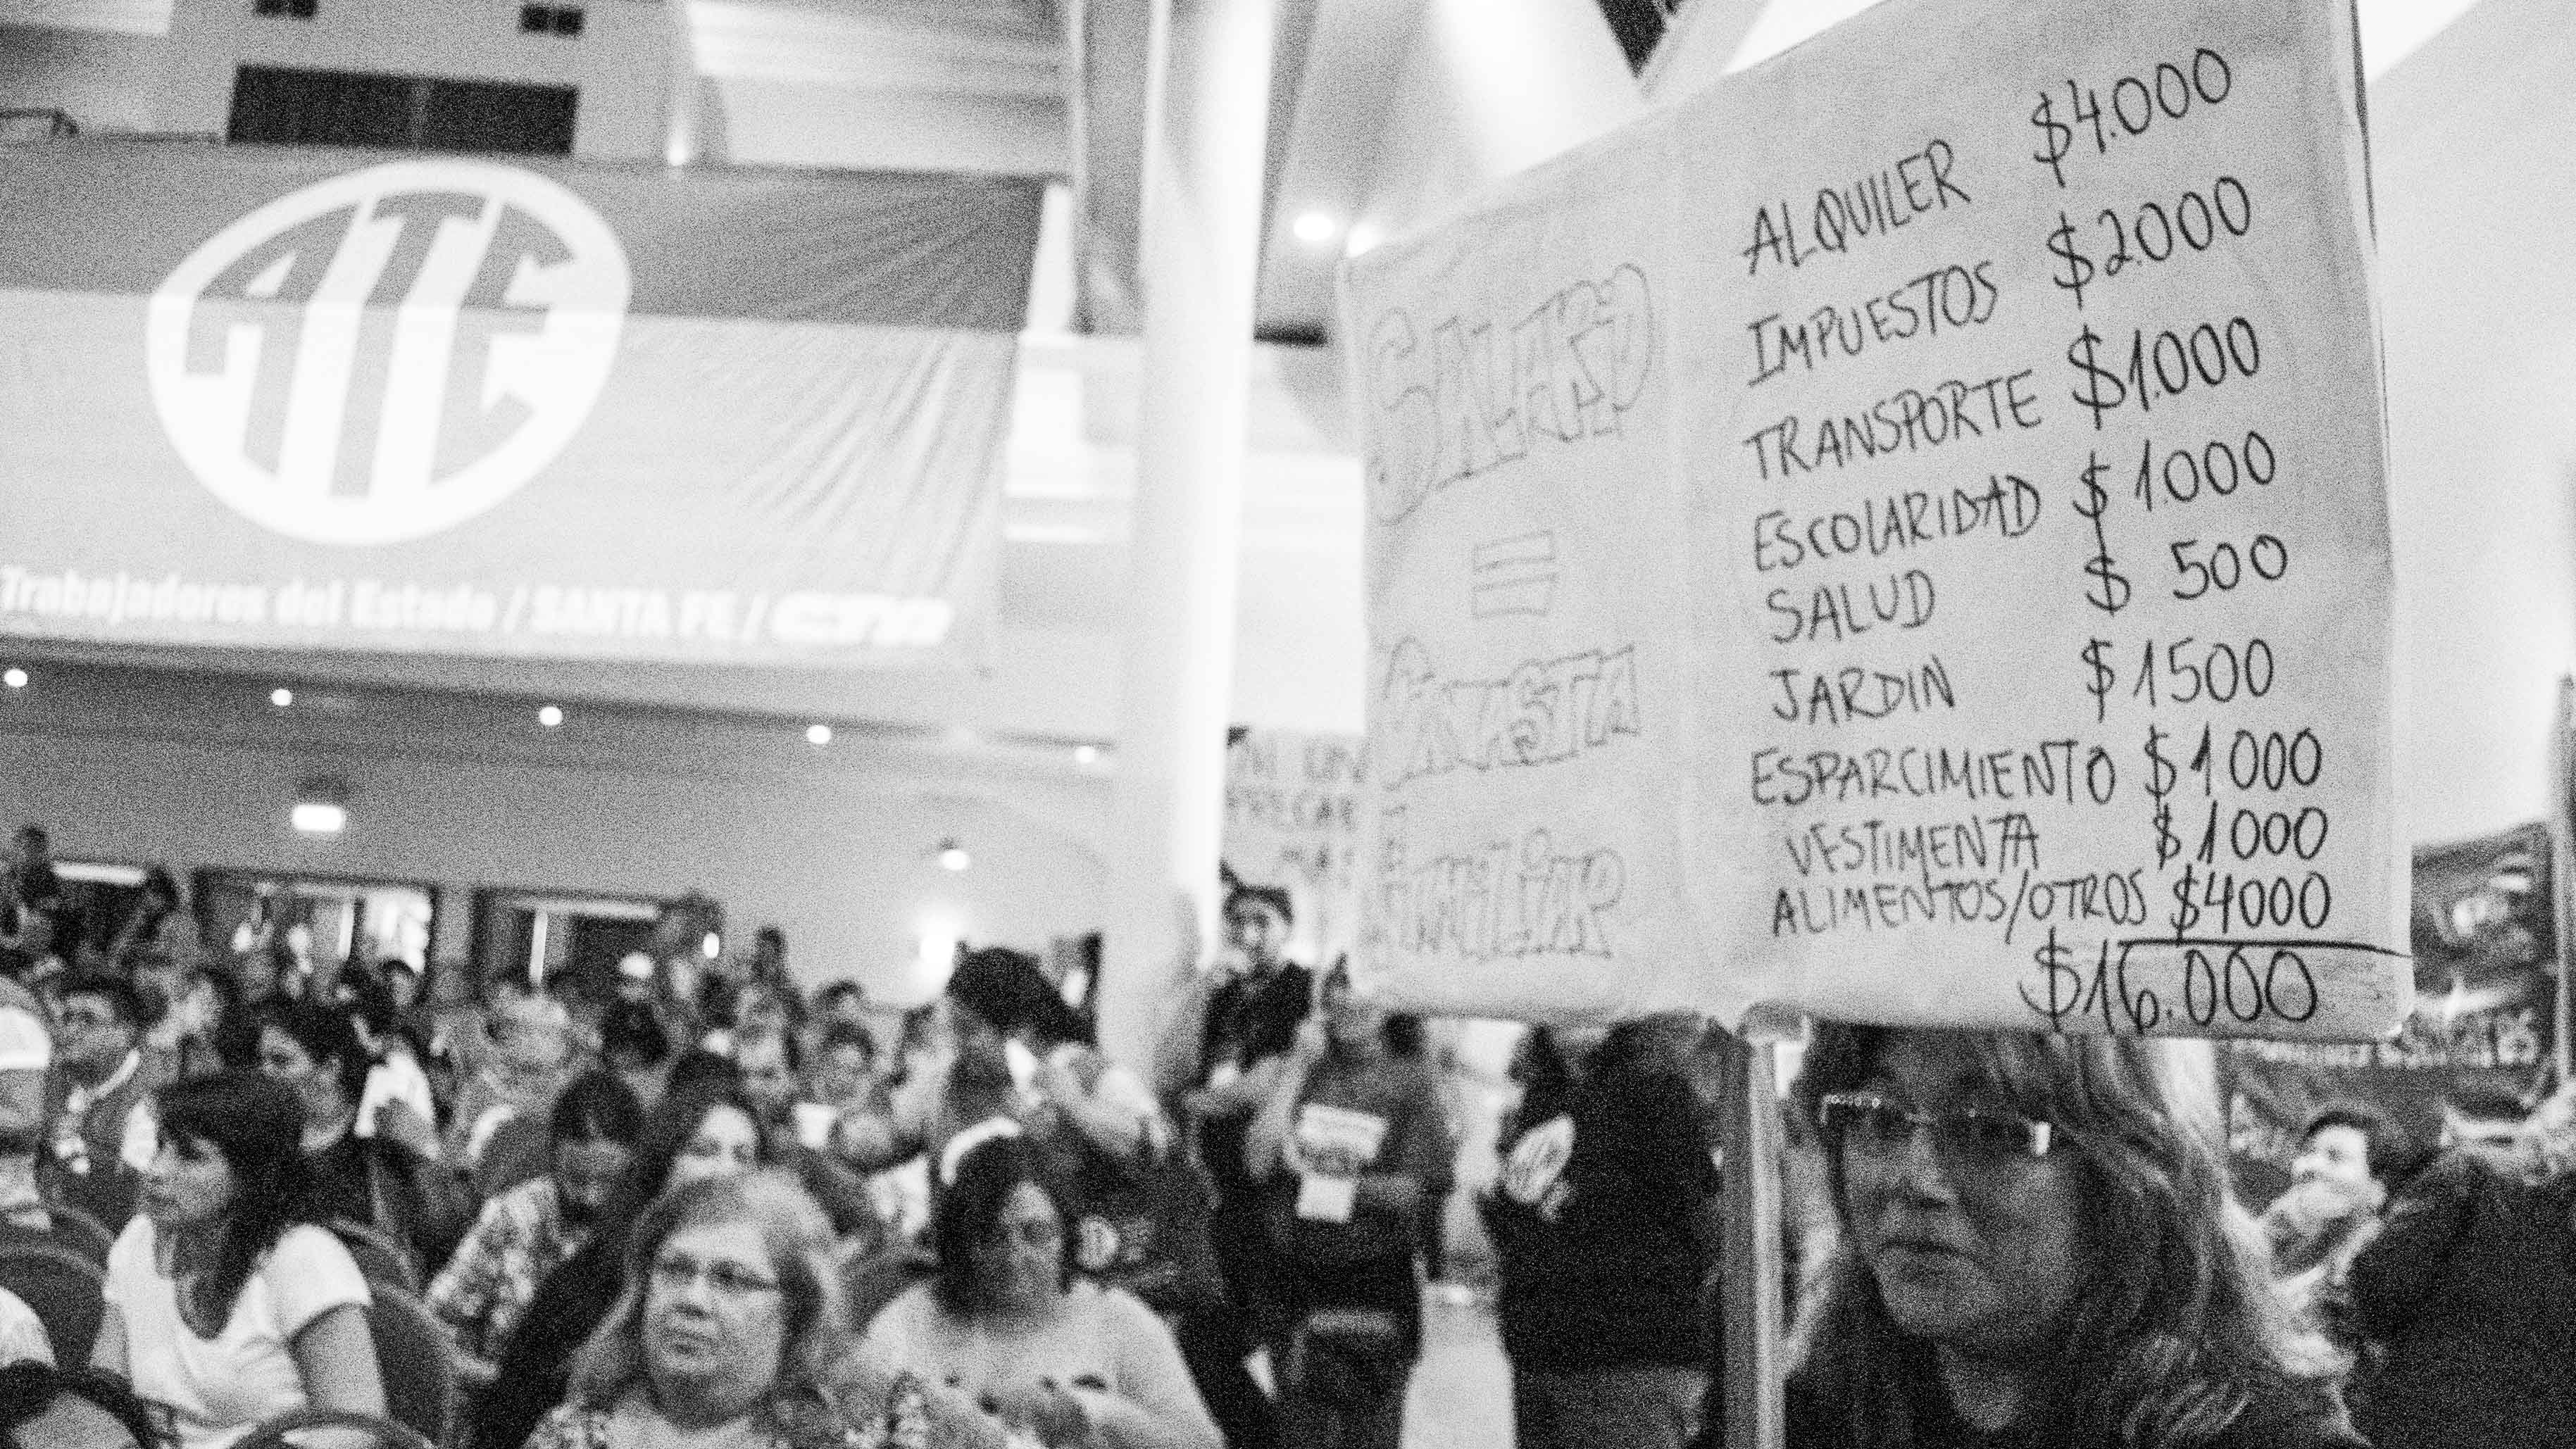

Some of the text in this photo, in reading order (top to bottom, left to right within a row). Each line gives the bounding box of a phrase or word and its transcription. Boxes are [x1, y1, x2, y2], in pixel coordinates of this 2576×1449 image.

[1744, 48, 2232, 275] ALQUILER $4.000
[185, 190, 577, 498] ATE
[1746, 261, 1999, 387] IMPUESTOS
[1743, 368, 2042, 479] TRANSPORTE
[1754, 475, 2040, 572] ESCOLARIDAD
[1, 562, 265, 628] Trabajadores
[280, 577, 344, 624] del
[351, 580, 494, 629] Estado
[531, 584, 670, 636] SANTA
[678, 589, 737, 639] FE
[1766, 569, 1935, 644] SALUD
[1768, 653, 1956, 727] JARDIN
[1750, 739, 2115, 807] ESPARCIMIENTO
[1783, 813, 2039, 876] VESTIMENTA
[2172, 864, 2331, 943] $4000
[2020, 927, 2317, 1034] $16.000
